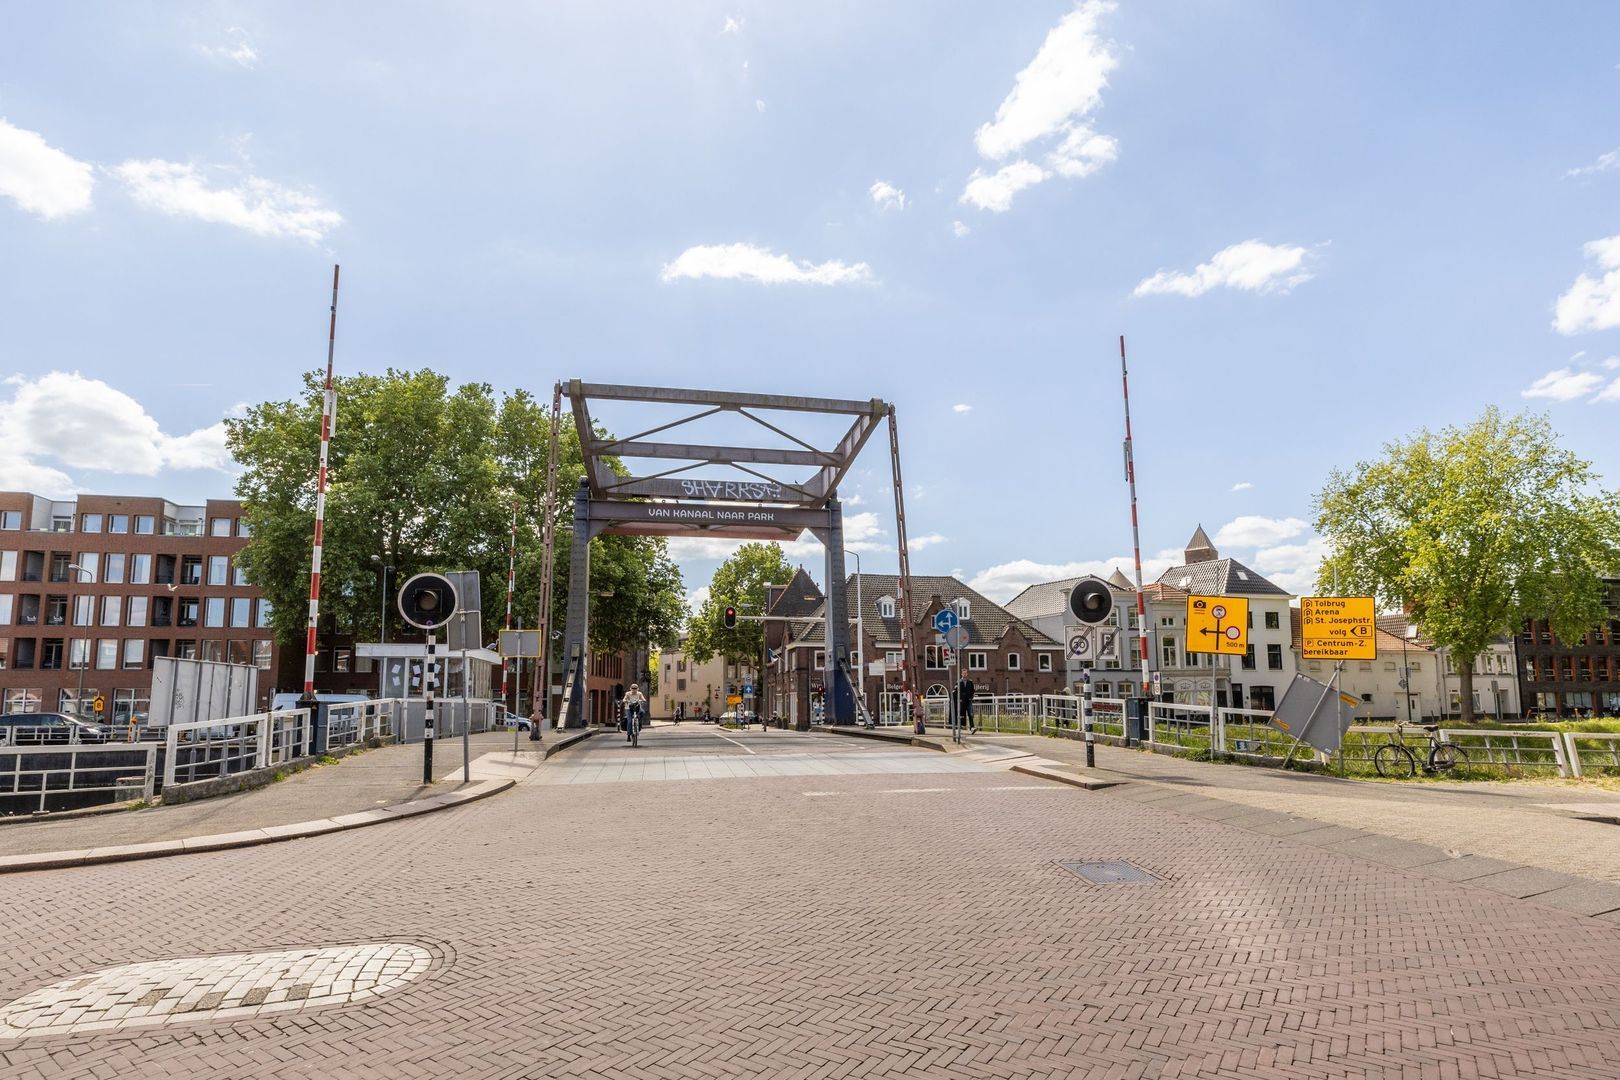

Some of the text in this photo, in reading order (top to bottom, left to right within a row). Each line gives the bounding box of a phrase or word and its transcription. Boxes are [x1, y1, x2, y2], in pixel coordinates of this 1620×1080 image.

[648, 508, 774, 521] VAN KANAAL NAAR PARK
[1315, 600, 1346, 608] Tolbrug
[1328, 617, 1373, 625] Josephstr.
[1360, 627, 1368, 635] B
[1317, 639, 1367, 647] Centrum-Z.
[1304, 648, 1349, 656] bereikbaar
